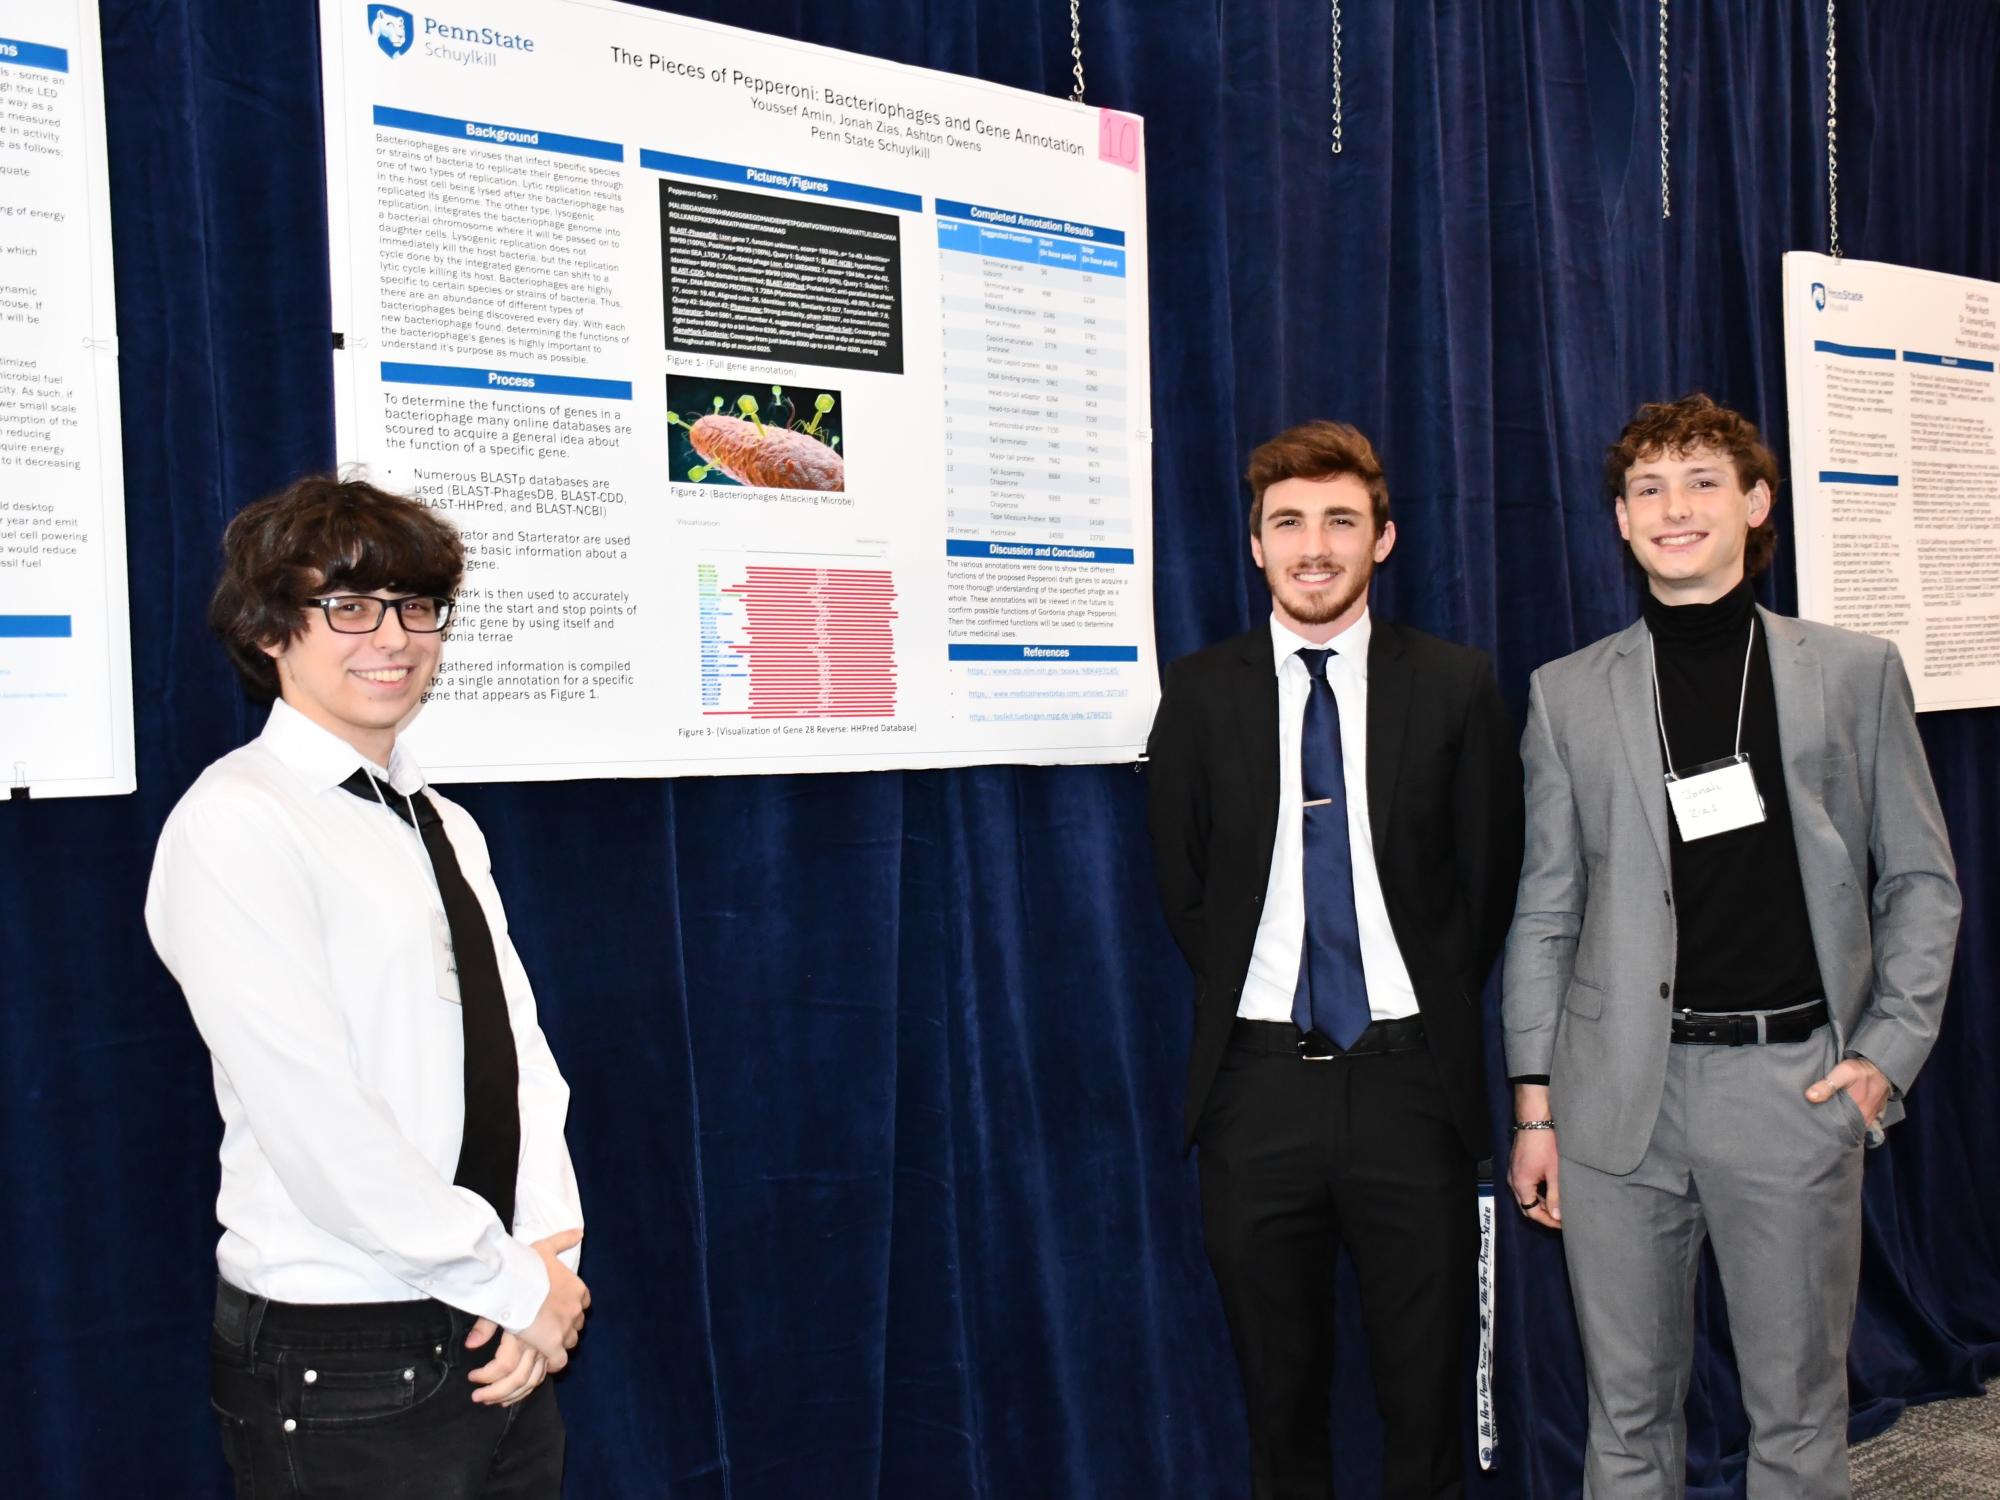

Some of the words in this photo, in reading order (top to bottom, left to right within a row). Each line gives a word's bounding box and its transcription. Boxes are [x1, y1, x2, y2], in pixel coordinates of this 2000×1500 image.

[424, 18, 535, 52] PennState
[425, 42, 497, 67] Schuylkill
[610, 46, 643, 66] The
[649, 54, 705, 78] Pieces
[710, 67, 727, 83] of
[824, 88, 940, 125] Bacteriophages
[944, 115, 970, 131] and
[975, 118, 1010, 139] Gene
[1014, 126, 1084, 154] Annotation
[7, 113, 60, 127] measured
[750, 97, 798, 116] Youssef
[839, 114, 872, 130] Jonah
[905, 126, 943, 144] Ashton
[946, 134, 982, 151] Owens
[9, 125, 20, 135] in
[22, 129, 59, 143] activity
[466, 123, 539, 145] Background
[1103, 116, 1136, 164] 10
[8, 142, 21, 150] as
[810, 126, 840, 142] Penn
[844, 132, 874, 148] State
[877, 138, 930, 159] Schuylkill
[375, 133, 449, 153] Bacteriophages
[452, 146, 467, 155] are
[469, 148, 502, 160] viruses
[504, 152, 523, 163] that
[525, 155, 550, 167] infect
[553, 161, 586, 172] specific
[588, 166, 620, 177] species
[747, 169, 829, 193] Pictures/Figures
[16, 206, 26, 216] of
[29, 209, 64, 222] energy
[970, 206, 1016, 224] Completed
[1018, 215, 1062, 232] Annotation
[1064, 223, 1094, 238] Results
[666, 354, 692, 366] Figure
[726, 362, 747, 371] gene
[488, 373, 535, 388] Process
[21, 386, 34, 396] As
[66, 390, 72, 399] if
[19, 402, 48, 411] small
[50, 403, 76, 413] scale
[383, 392, 398, 403] To
[401, 393, 465, 408] determine
[468, 398, 488, 409] the
[491, 399, 546, 413] functions
[549, 404, 560, 414] of
[563, 407, 597, 418] genes
[600, 407, 610, 418] in
[614, 410, 621, 419] a
[384, 407, 473, 425] bacteriophage
[477, 415, 510, 428] many
[512, 416, 549, 428] online
[552, 418, 611, 432] databases
[614, 424, 632, 433] are
[6, 428, 51, 441] reducing
[385, 424, 434, 435] scoured
[438, 424, 450, 436] to
[453, 428, 498, 440] acquire
[501, 431, 509, 439] a
[512, 431, 556, 443] general
[560, 432, 584, 444] idea
[587, 434, 619, 446] about
[386, 436, 406, 448] the
[409, 437, 459, 451] function
[463, 441, 475, 452] of
[478, 444, 486, 452] a
[489, 444, 535, 456] specific
[413, 467, 476, 481] Numerous
[480, 470, 525, 486] BLASTp
[528, 473, 588, 487] databases
[591, 479, 609, 488] are
[414, 482, 444, 494] used
[670, 486, 697, 498] Figure
[780, 492, 819, 506] Attacking
[12, 501, 54, 514] desktop
[510, 501, 532, 512] and
[6, 517, 28, 526] year
[32, 516, 52, 526] and
[54, 518, 78, 527] emit
[492, 529, 514, 540] and
[517, 530, 580, 543] Starterator
[583, 535, 601, 543] are
[604, 534, 630, 544] used
[7, 544, 38, 554] would
[42, 545, 77, 554] reduce
[480, 543, 512, 554] basic
[515, 544, 582, 557] information
[585, 546, 617, 558] about
[620, 550, 627, 558] a
[990, 544, 1033, 556] Discussion
[1035, 546, 1050, 557] and
[1052, 547, 1095, 558] Conclusion
[1024, 647, 1070, 658] References
[438, 659, 493, 673] gathered
[496, 659, 564, 670] information
[567, 659, 577, 670] is
[579, 659, 630, 672] compiled
[447, 676, 454, 685] a
[458, 674, 493, 687] single
[497, 673, 560, 685] annotation
[563, 673, 578, 684] for
[581, 676, 589, 684] a
[591, 673, 634, 686] specific
[454, 688, 478, 699] that
[482, 690, 530, 702] appears
[533, 690, 547, 698] as
[550, 687, 585, 701] Figure
[678, 727, 704, 738] Figure
[772, 725, 781, 734] of
[782, 725, 803, 734] Gene
[805, 724, 815, 733] 28
[850, 723, 879, 732] HHPred
[1480, 1206, 1491, 1234] State
[1480, 1238, 1489, 1266] Penn
